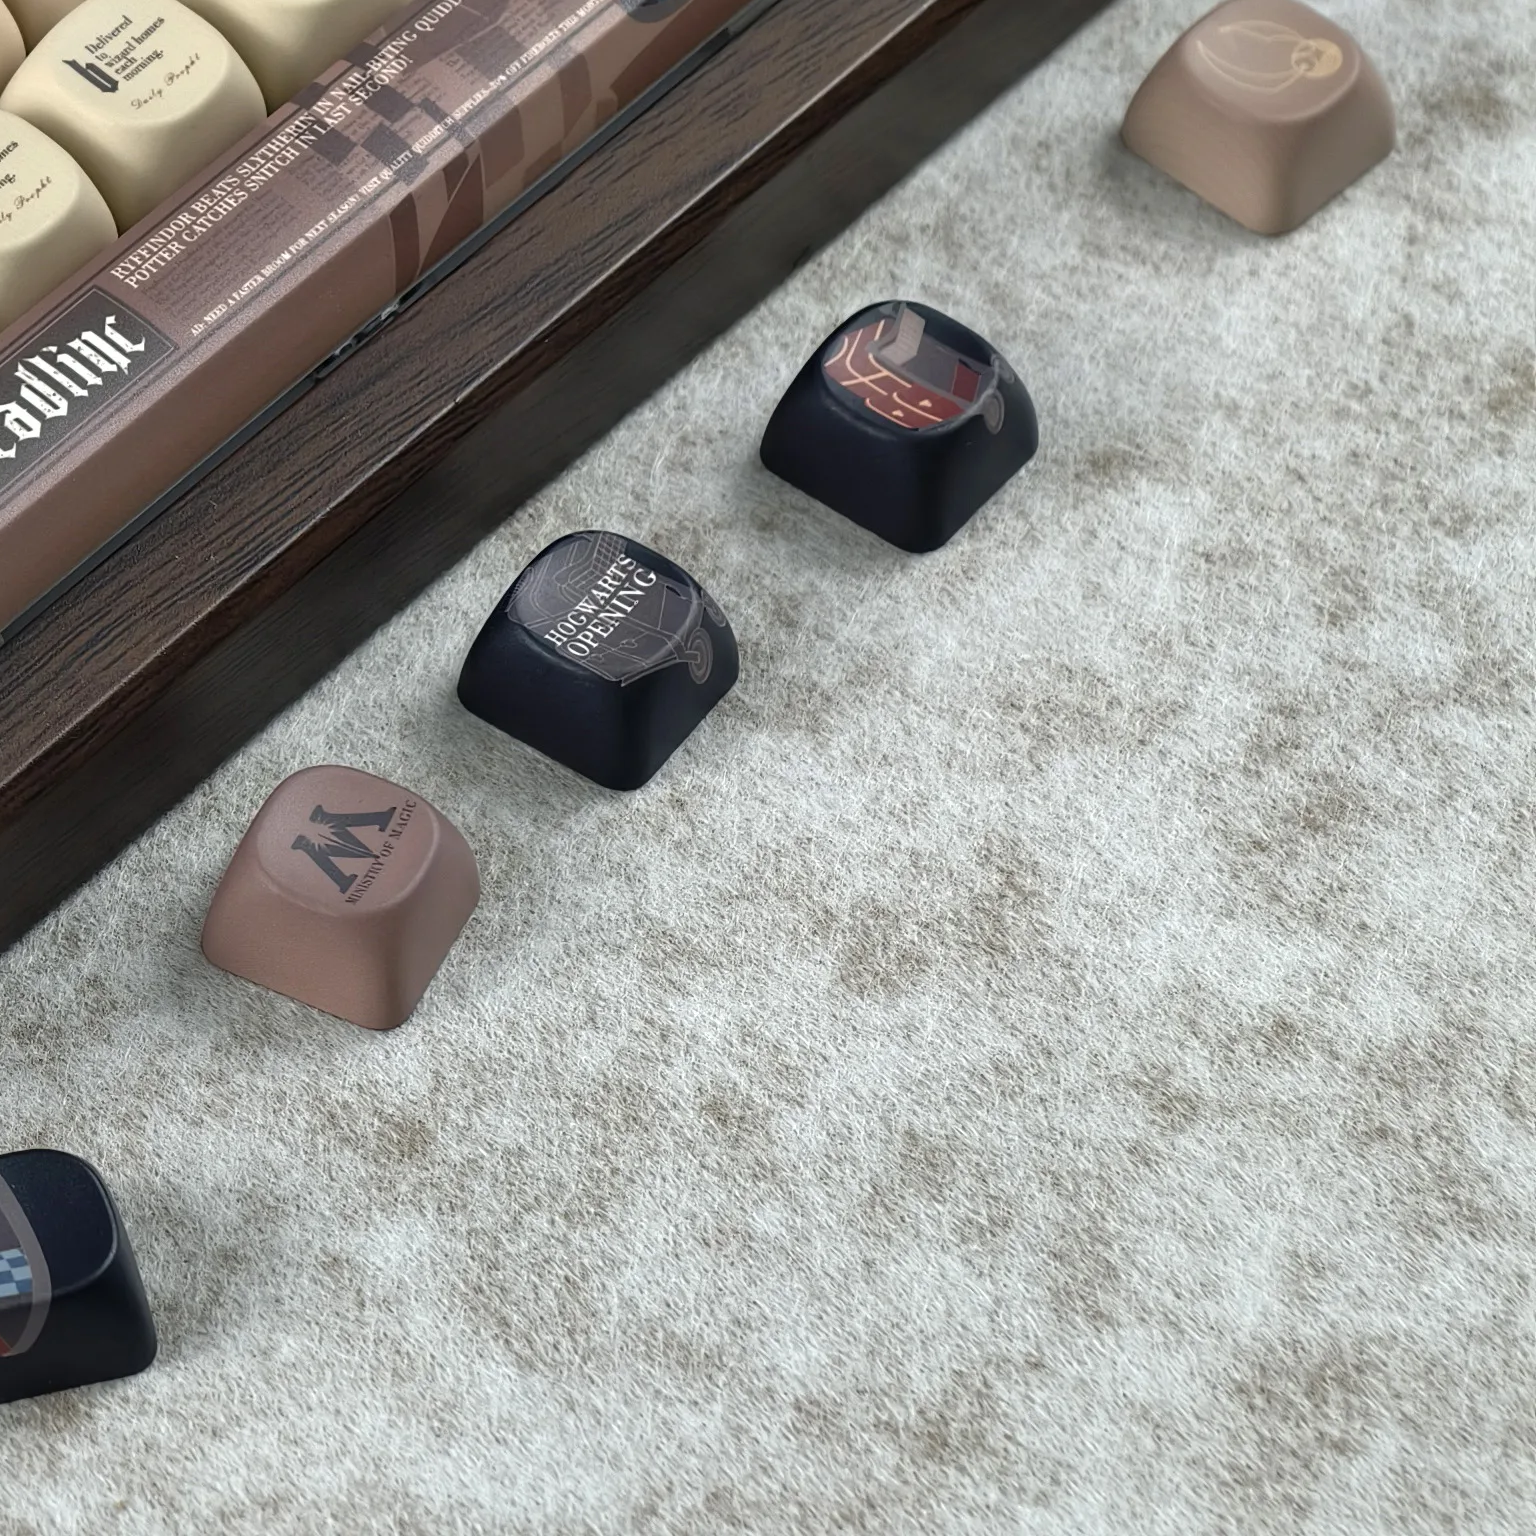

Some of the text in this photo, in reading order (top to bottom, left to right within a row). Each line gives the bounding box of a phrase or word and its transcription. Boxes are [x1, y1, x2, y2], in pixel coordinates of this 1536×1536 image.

[84, 15, 133, 54] Delivered
[104, 17, 165, 68] wizard homes
[122, 49, 164, 81] morning.
[110, 212, 196, 280] RYFFINDOR
[191, 175, 240, 214] BEATS
[236, 112, 317, 177] SLYTHERIN
[312, 98, 333, 116] IN
[330, 30, 417, 101] NAIL-BITING
[124, 241, 186, 289] POTTER
[182, 189, 248, 242] CATCHES
[244, 147, 300, 192] SNITCH
[295, 133, 318, 149] IN
[313, 102, 352, 135] LAST
[348, 54, 413, 106] SECOND!
[203, 303, 228, 323] NEED
[232, 274, 265, 301] FASTER
[260, 250, 292, 278] BROOM
[288, 238, 309, 254] FOR
[304, 220, 329, 241] NEXT
[359, 176, 381, 195] VISIT
[379, 150, 413, 180] QUALITY
[544, 554, 636, 647] HOGWARTS
[567, 568, 656, 656] OPENING
[345, 799, 417, 905] MINISTRY OF MAGIC
